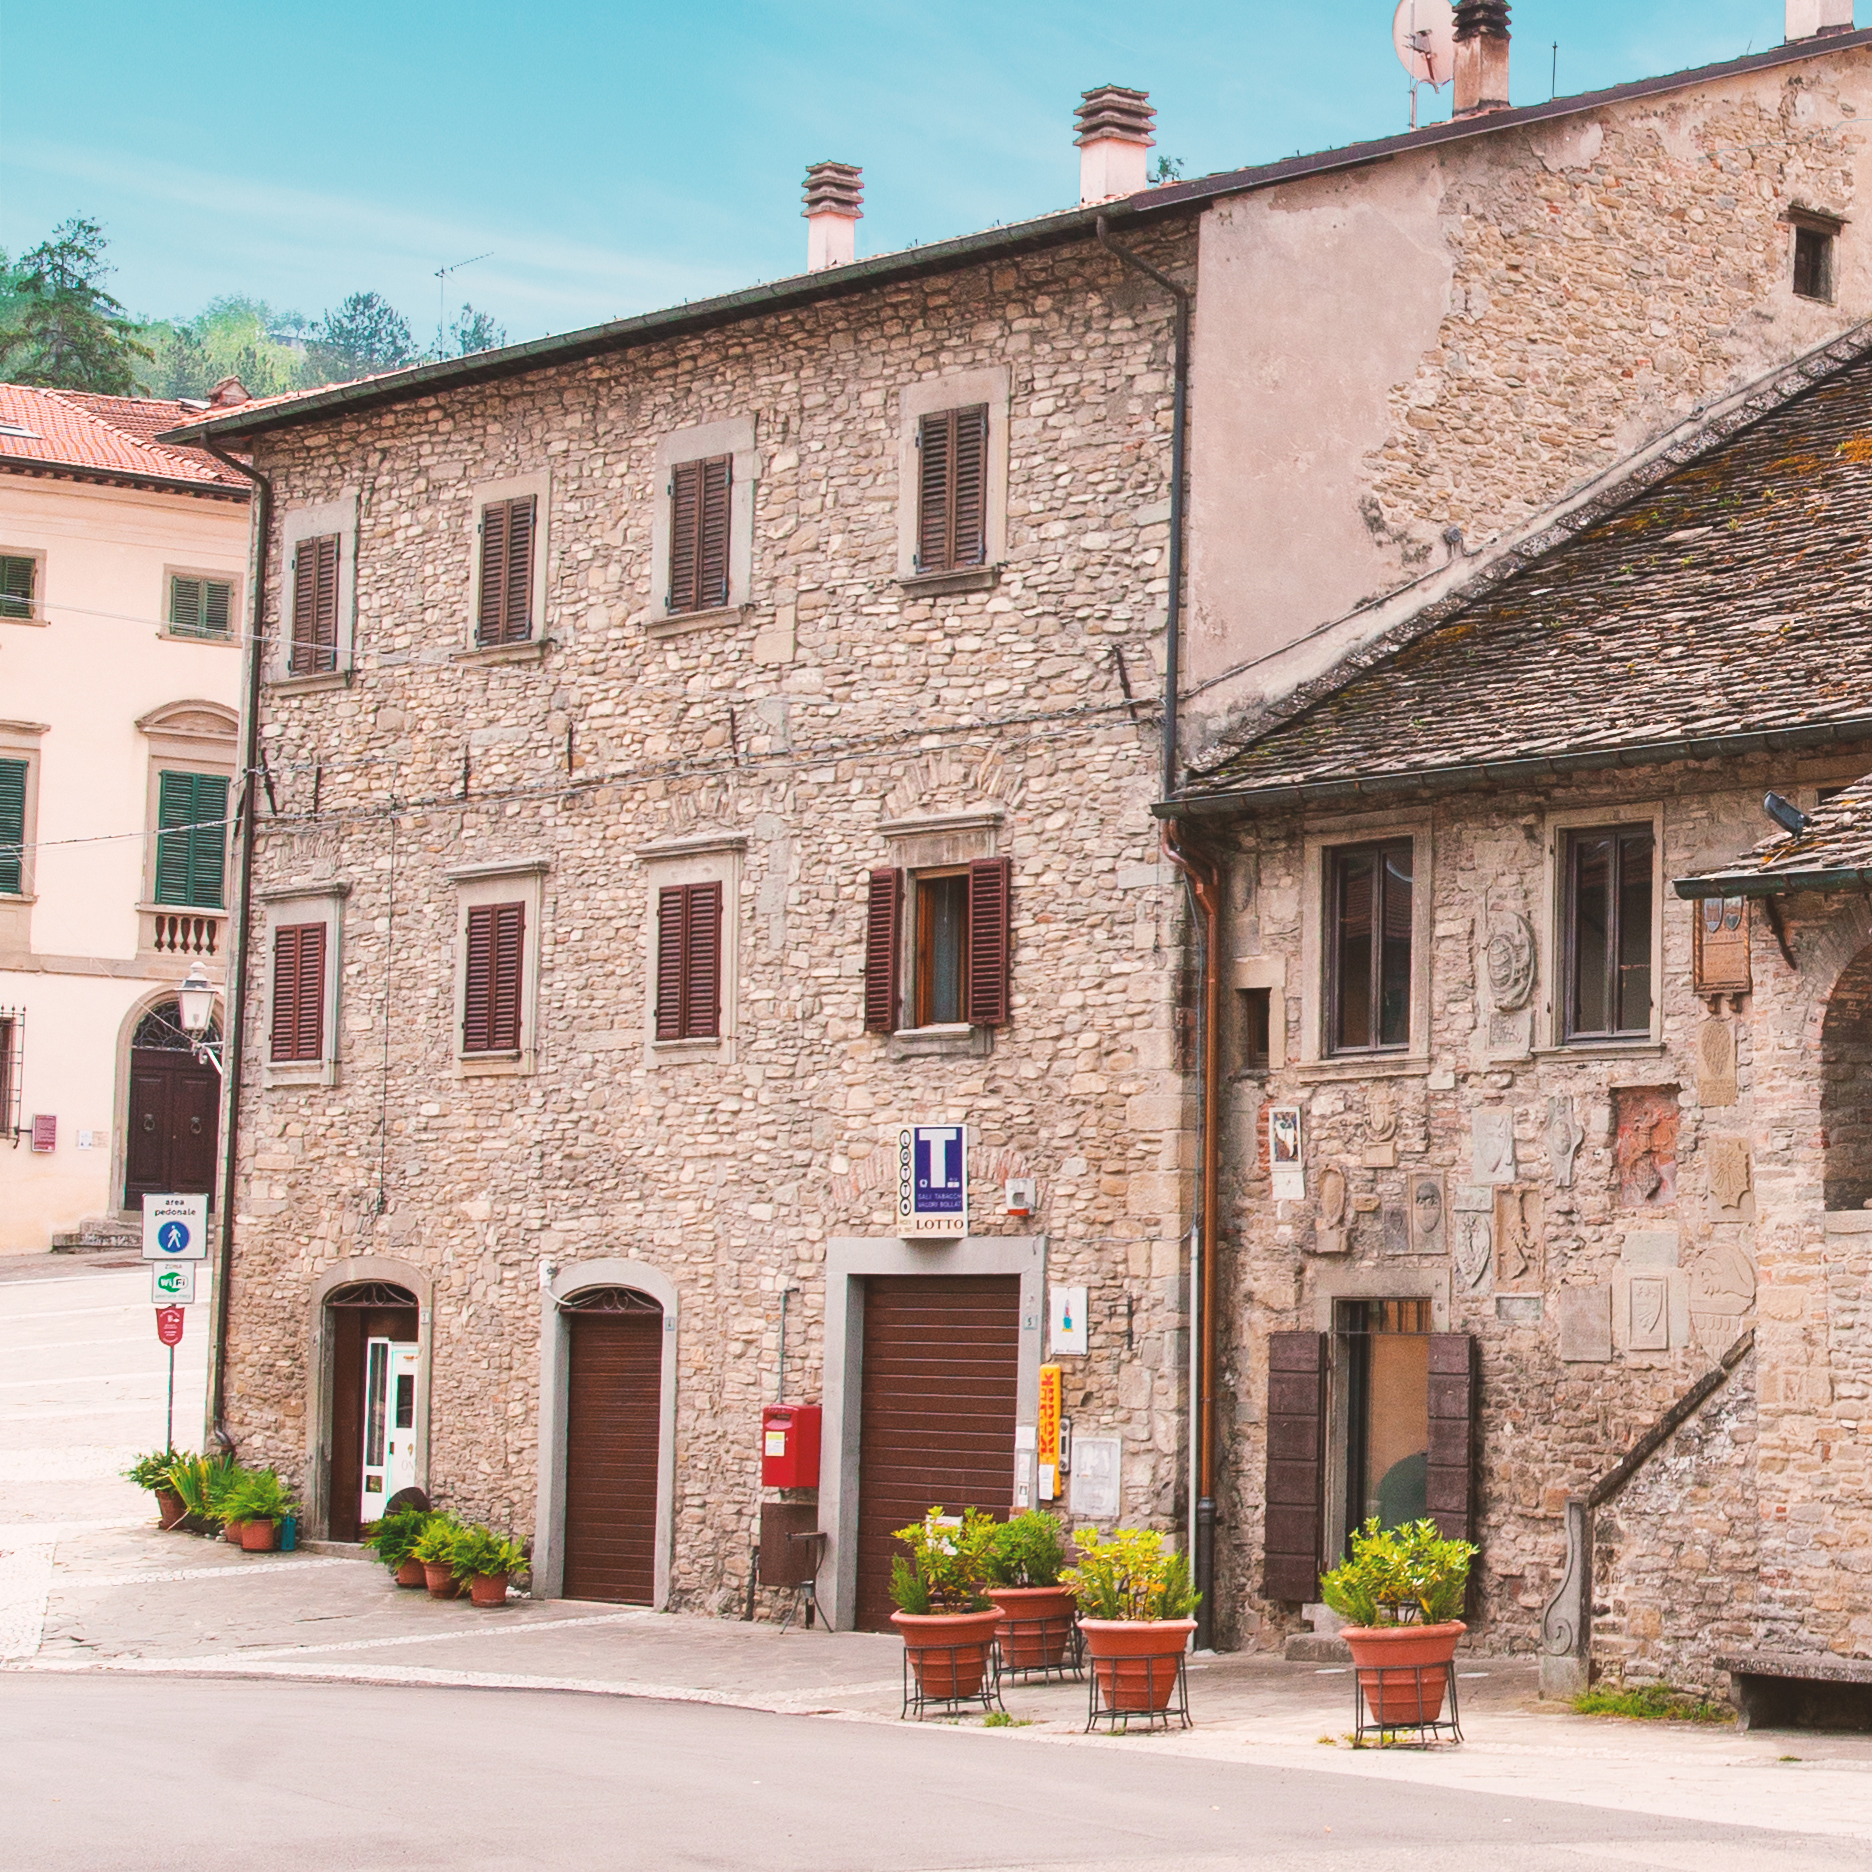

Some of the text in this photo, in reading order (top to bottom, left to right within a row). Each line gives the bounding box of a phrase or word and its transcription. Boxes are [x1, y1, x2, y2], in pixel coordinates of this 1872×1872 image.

[935, 1192, 962, 1200] TABACCH
[940, 1200, 962, 1208] BOLLAT
[154, 1208, 196, 1217] pedonale
[916, 1219, 964, 1230] LOTTO
[1041, 1372, 1055, 1454] Kodak
